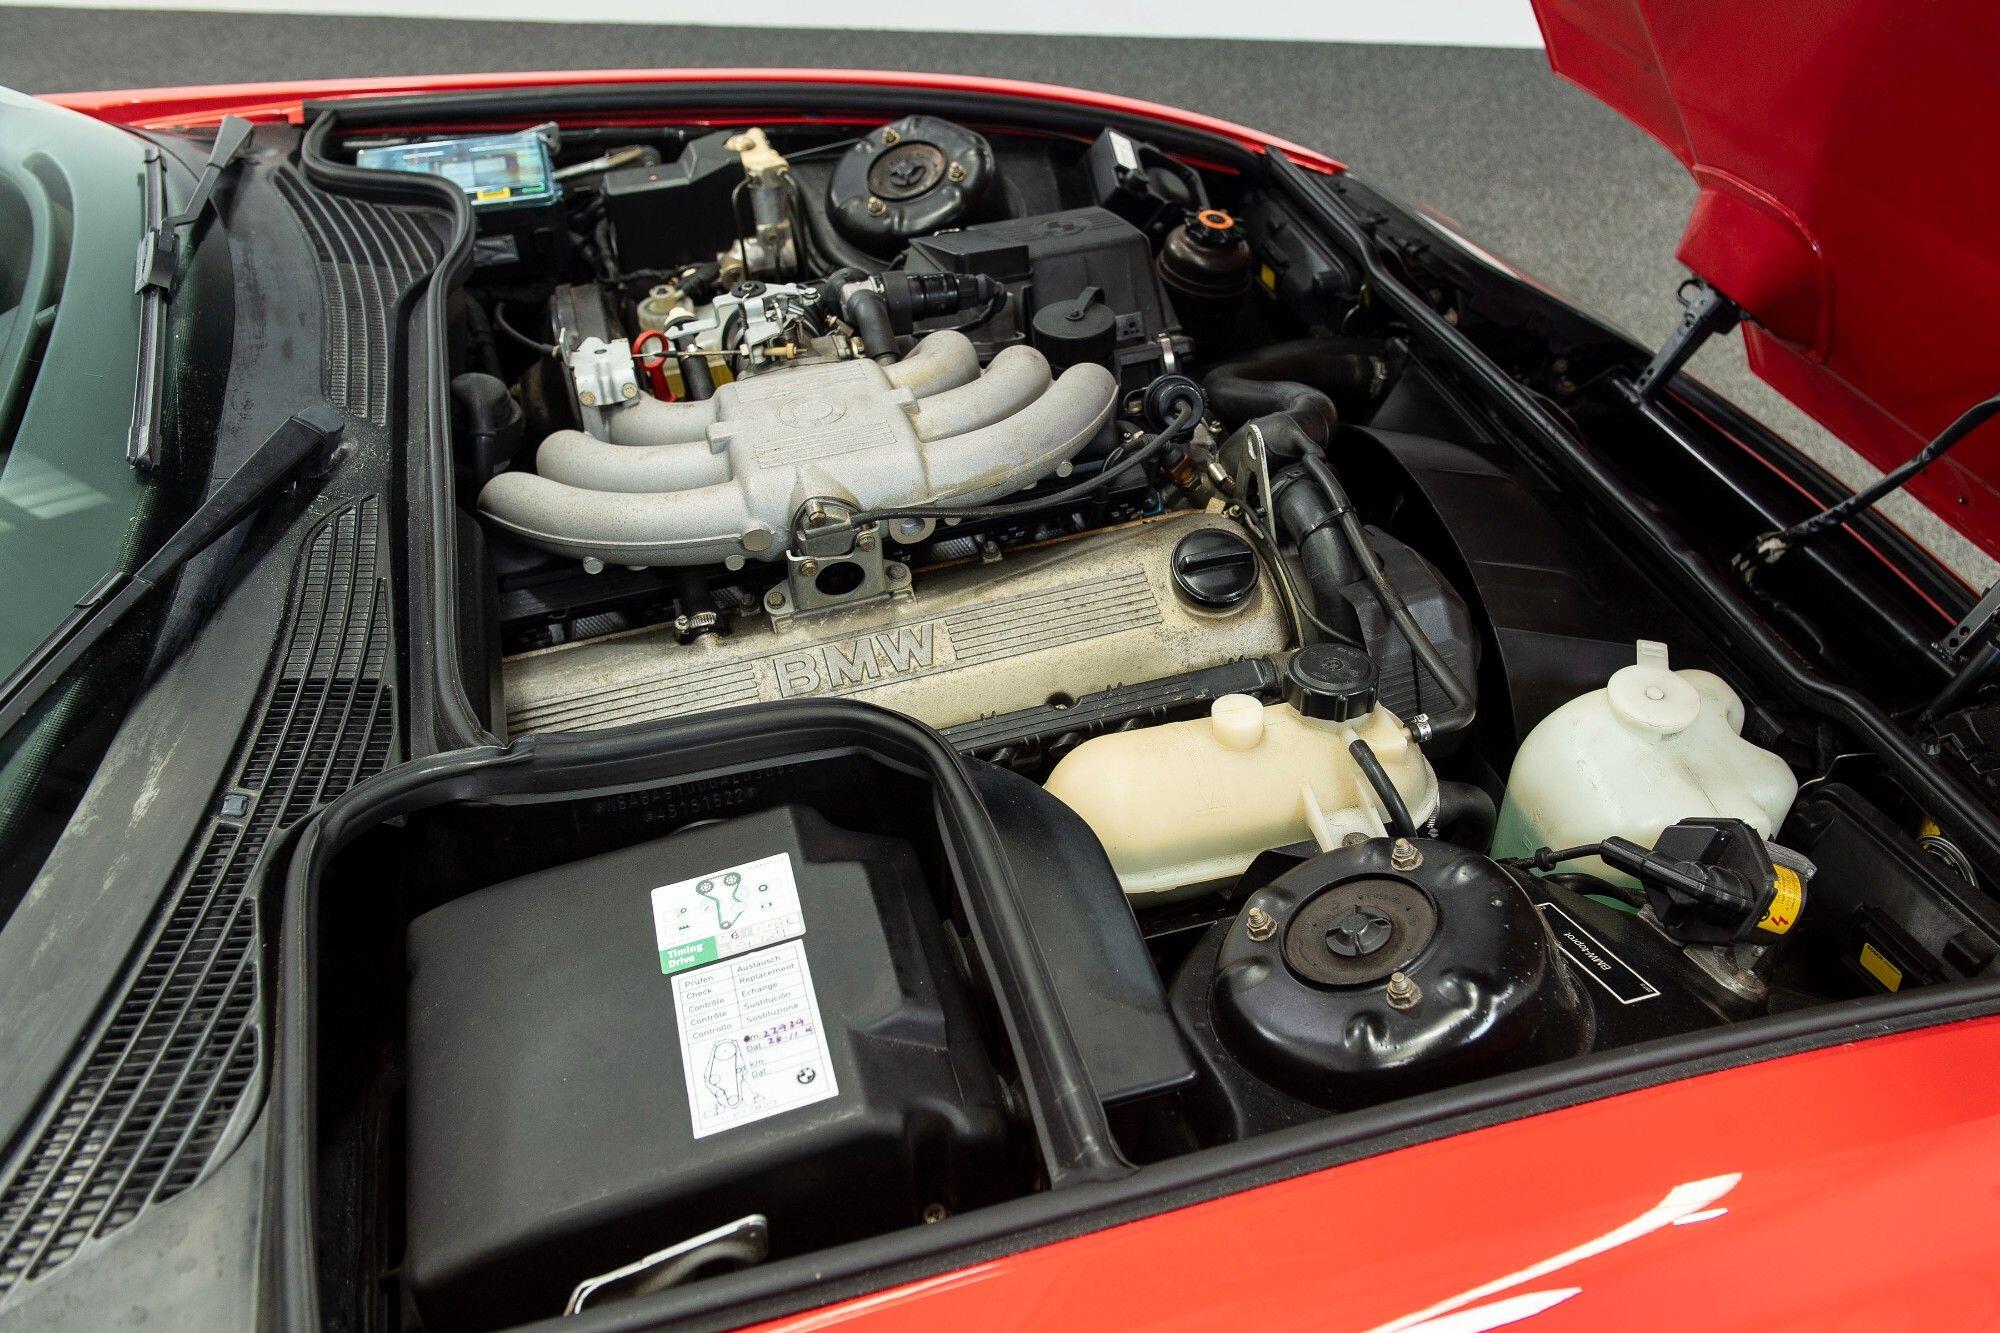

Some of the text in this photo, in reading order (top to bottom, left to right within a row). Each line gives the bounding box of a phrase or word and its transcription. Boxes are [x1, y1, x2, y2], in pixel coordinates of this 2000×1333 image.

[773, 624, 934, 698] BMW
[666, 943, 704, 959] Timing
[668, 955, 696, 968] Drive
[737, 955, 781, 973] Austausch
[739, 963, 795, 984] Replacement
[686, 988, 712, 1000] Check
[692, 1023, 732, 1040] Controllo
